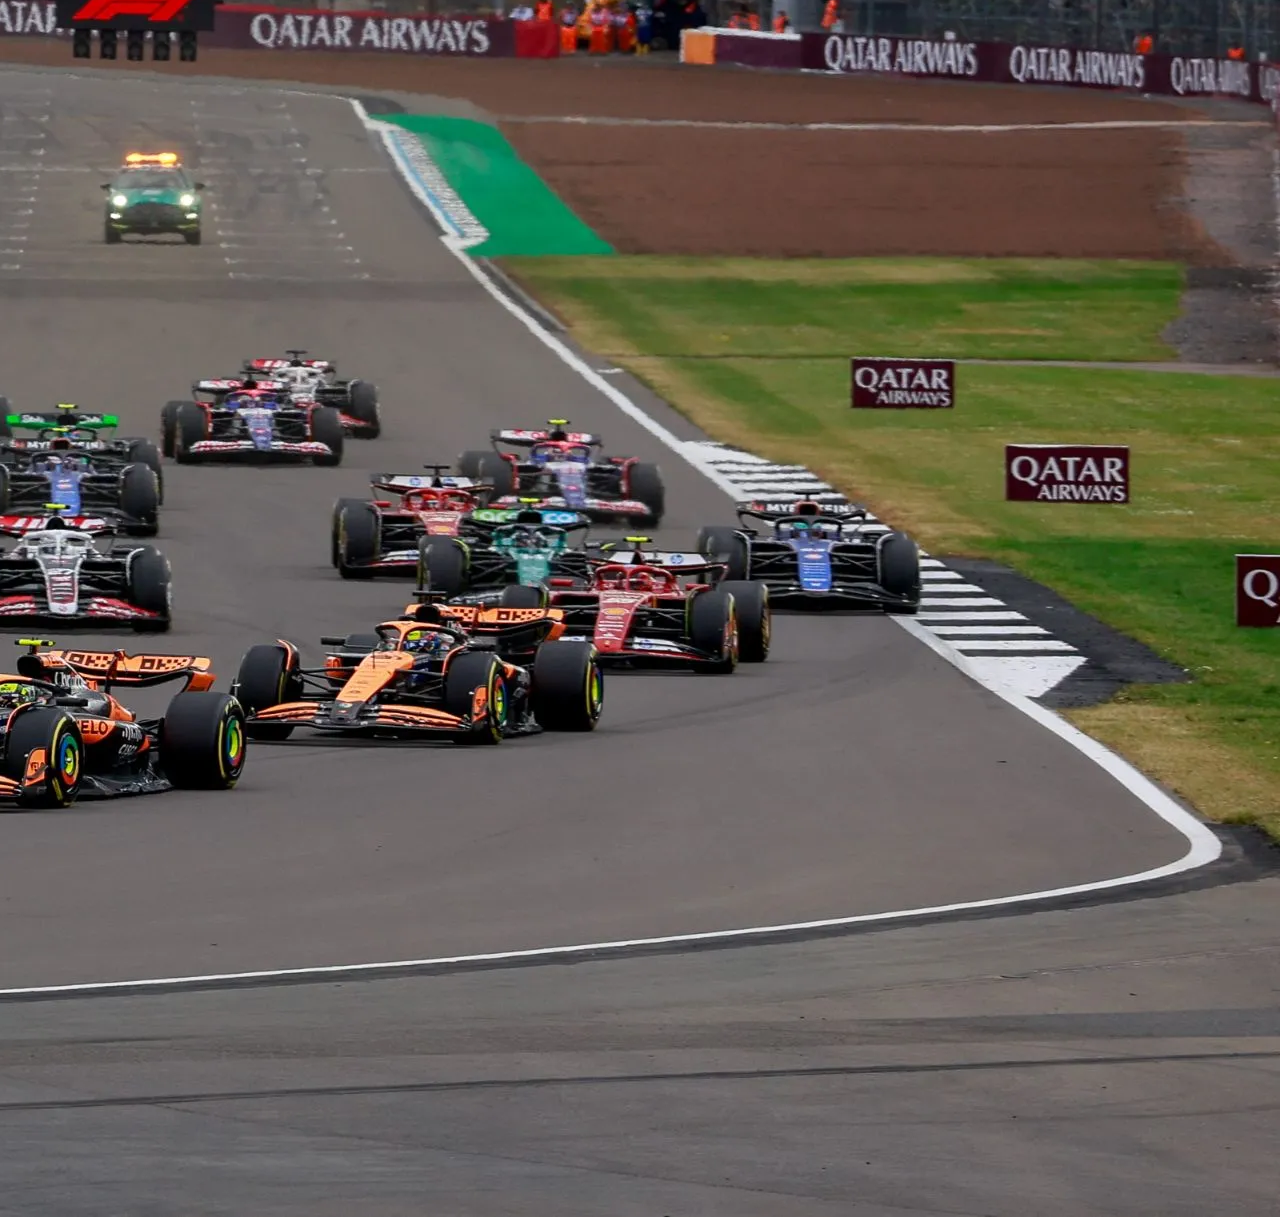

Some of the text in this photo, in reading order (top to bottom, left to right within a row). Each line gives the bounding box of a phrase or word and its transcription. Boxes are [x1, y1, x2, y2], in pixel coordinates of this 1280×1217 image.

[250, 12, 491, 53] QATAR AIRWAYS
[824, 34, 892, 71] QATAR
[1008, 44, 1072, 82] QATAR
[854, 366, 950, 394] QATAR
[876, 390, 952, 407] AIRWAYS
[1010, 455, 1126, 486] QATAR
[1037, 484, 1127, 503] AIRWAYS
